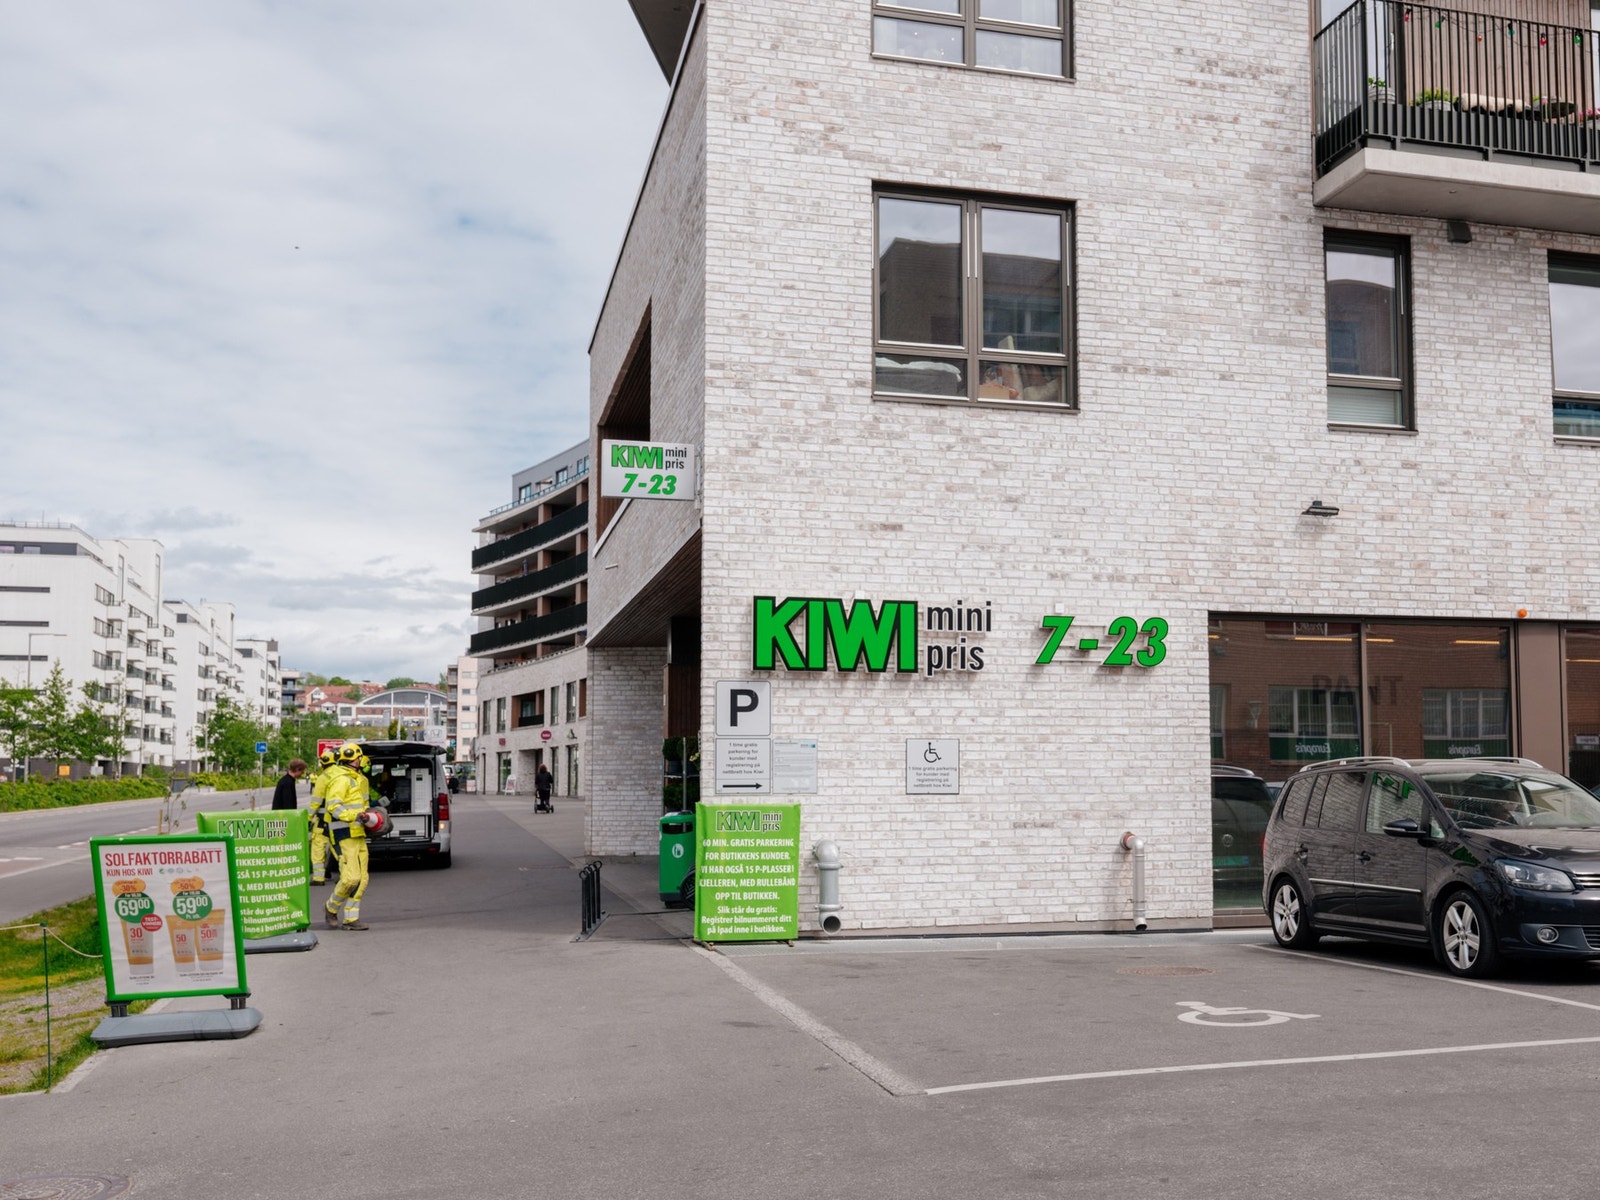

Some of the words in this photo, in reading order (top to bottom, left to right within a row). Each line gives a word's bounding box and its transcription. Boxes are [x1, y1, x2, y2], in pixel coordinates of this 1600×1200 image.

[611, 444, 663, 469] KIWI
[665, 447, 687, 458] mini
[665, 459, 685, 470] pris
[926, 600, 992, 632] mini
[752, 595, 919, 674] KIWI
[926, 638, 985, 677] pris
[730, 689, 759, 727] P
[716, 810, 761, 832] KIWI
[762, 812, 782, 821] mini
[217, 818, 266, 839] KIWI
[267, 819, 288, 829] mini
[762, 822, 781, 833] pris
[267, 829, 287, 840] pris
[235, 845, 260, 854] GRATIS
[261, 842, 302, 853] PARKERING
[712, 838, 728, 847] MIN.
[730, 838, 755, 847] GRATIS
[757, 838, 794, 847] PARKERING
[104, 849, 222, 867] SOLFAKTORRABATT
[267, 856, 300, 866] KUNDER.
[705, 852, 719, 860] FOR
[721, 852, 760, 860] BUTIKKENS
[106, 868, 122, 877] KUN
[122, 868, 136, 876] HOS
[137, 867, 153, 876] KIWI
[252, 870, 260, 878] 15
[262, 867, 301, 878] P-PLASSER
[701, 865, 708, 873] VI
[709, 865, 724, 873] HAR
[725, 864, 744, 873] OGSÅ
[745, 865, 754, 873] 15
[755, 865, 792, 873] P-PLASSER
[247, 882, 263, 891] MED
[264, 877, 306, 890] RULLEBÅND
[740, 879, 756, 887] MED
[757, 877, 796, 887] RULLEBÅND
[239, 895, 250, 903] TIL
[251, 893, 291, 903] BUTIKKEN.
[715, 892, 730, 900] OPP
[731, 892, 742, 900] TIL
[743, 892, 780, 900] BUTIKKEN.
[255, 907, 264, 915] du
[265, 905, 289, 916] gratis:
[717, 905, 730, 914] Slik
[731, 906, 745, 914] står
[745, 906, 755, 914] du
[756, 905, 778, 915] gratis:
[243, 914, 290, 924] bilnummeret
[291, 911, 304, 919] ditt
[701, 916, 733, 925] Registrer
[734, 915, 778, 924] bilnummeret
[779, 914, 792, 923] ditt
[130, 927, 143, 938] 30
[245, 925, 260, 934] inne
[265, 921, 298, 932] butikken.
[707, 926, 716, 935] på
[734, 925, 749, 934] inne
[754, 925, 786, 934] butikken.
[175, 934, 187, 943] 50
